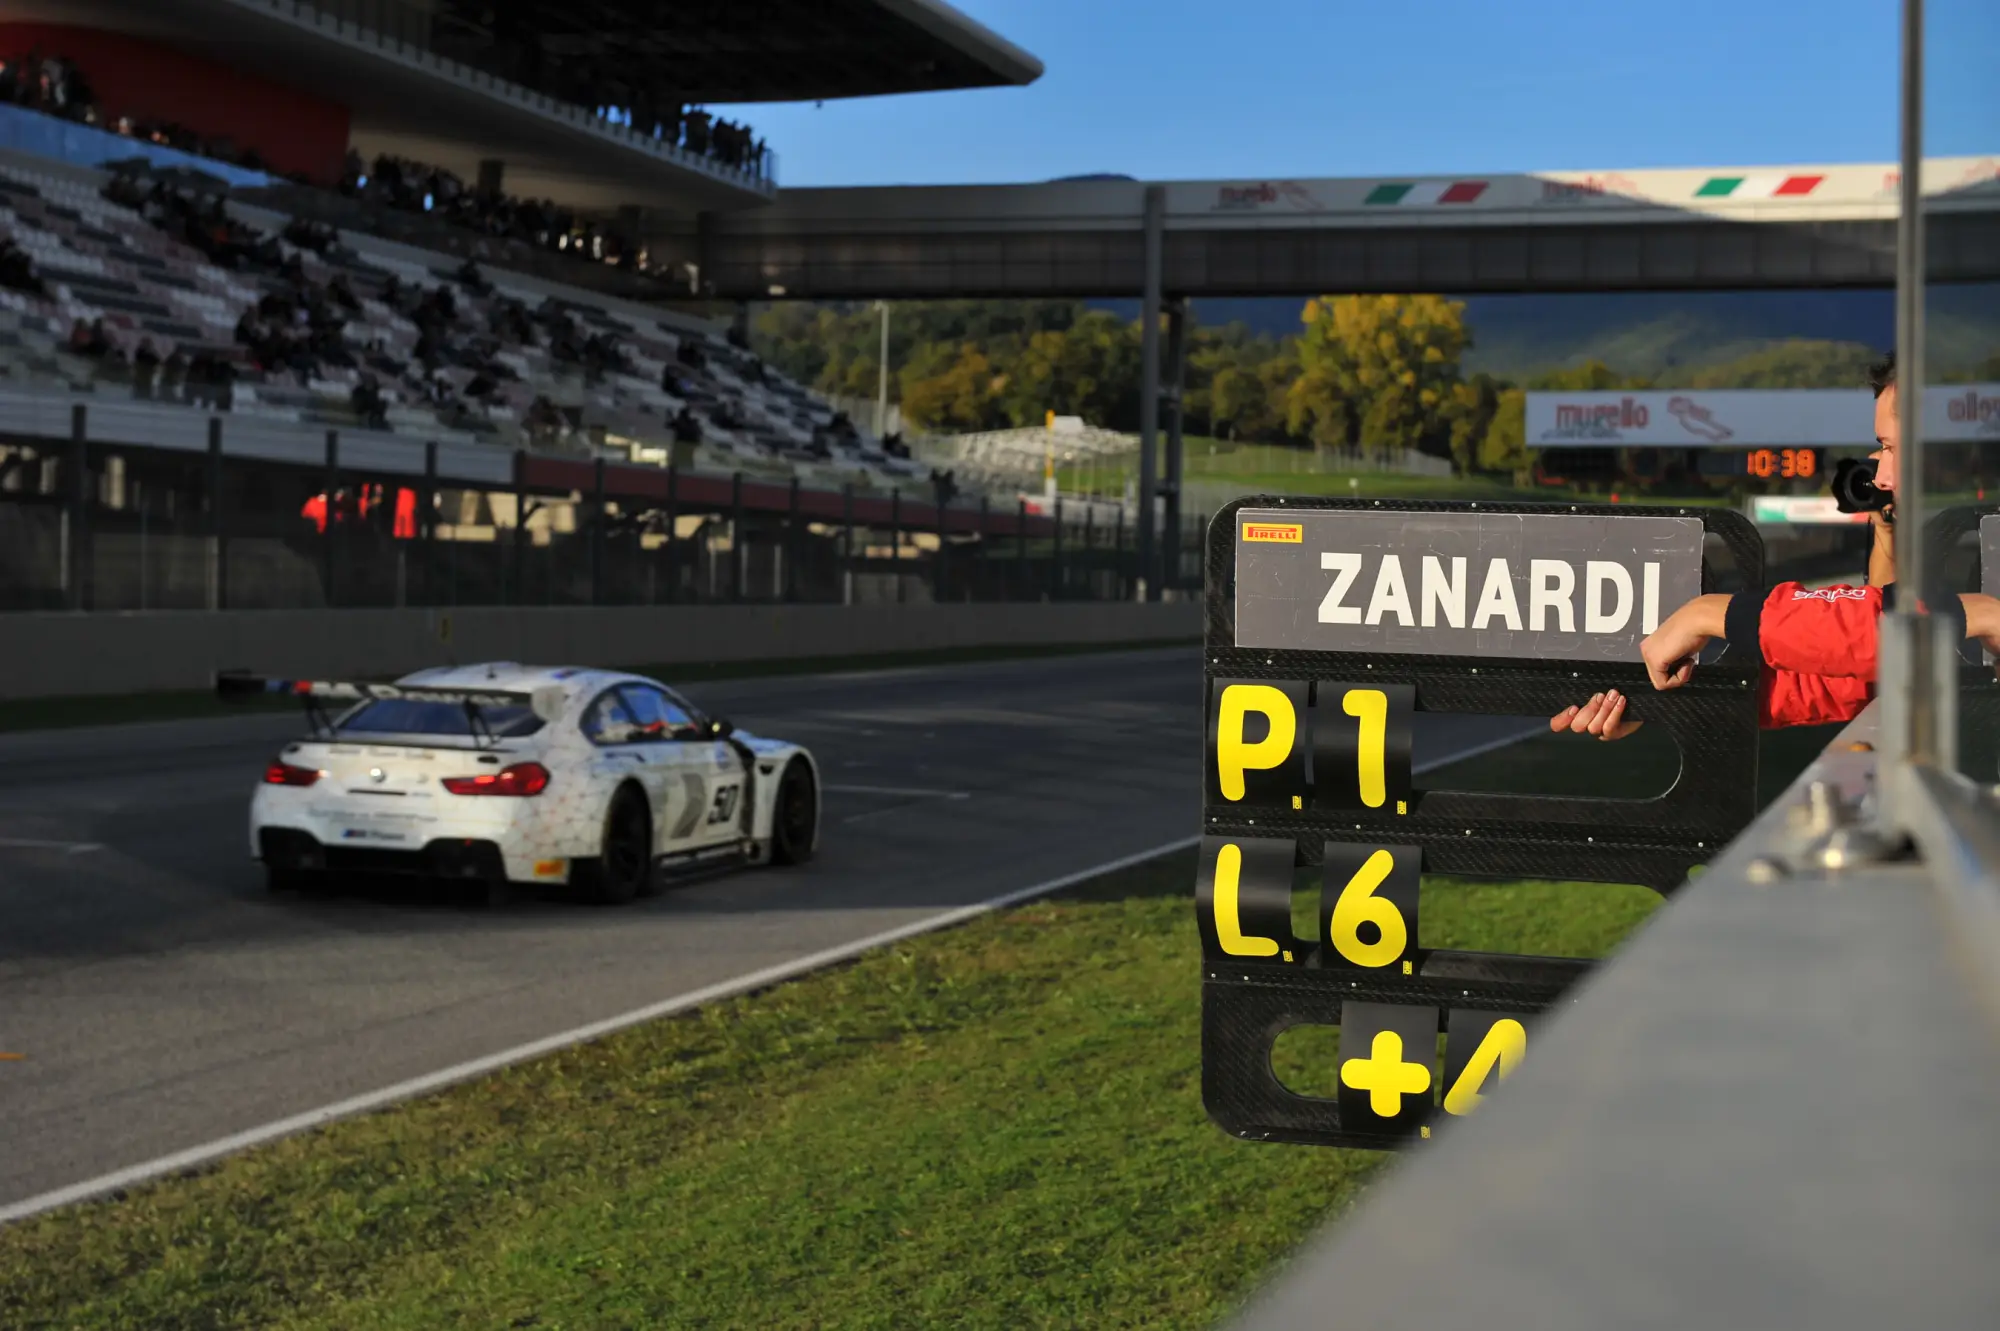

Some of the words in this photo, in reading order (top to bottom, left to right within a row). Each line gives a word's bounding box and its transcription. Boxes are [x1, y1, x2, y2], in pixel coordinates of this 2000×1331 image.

[1247, 526, 1297, 540] PIRELLI
[1318, 552, 1661, 634] ZANARDI
[707, 785, 740, 825] 50
